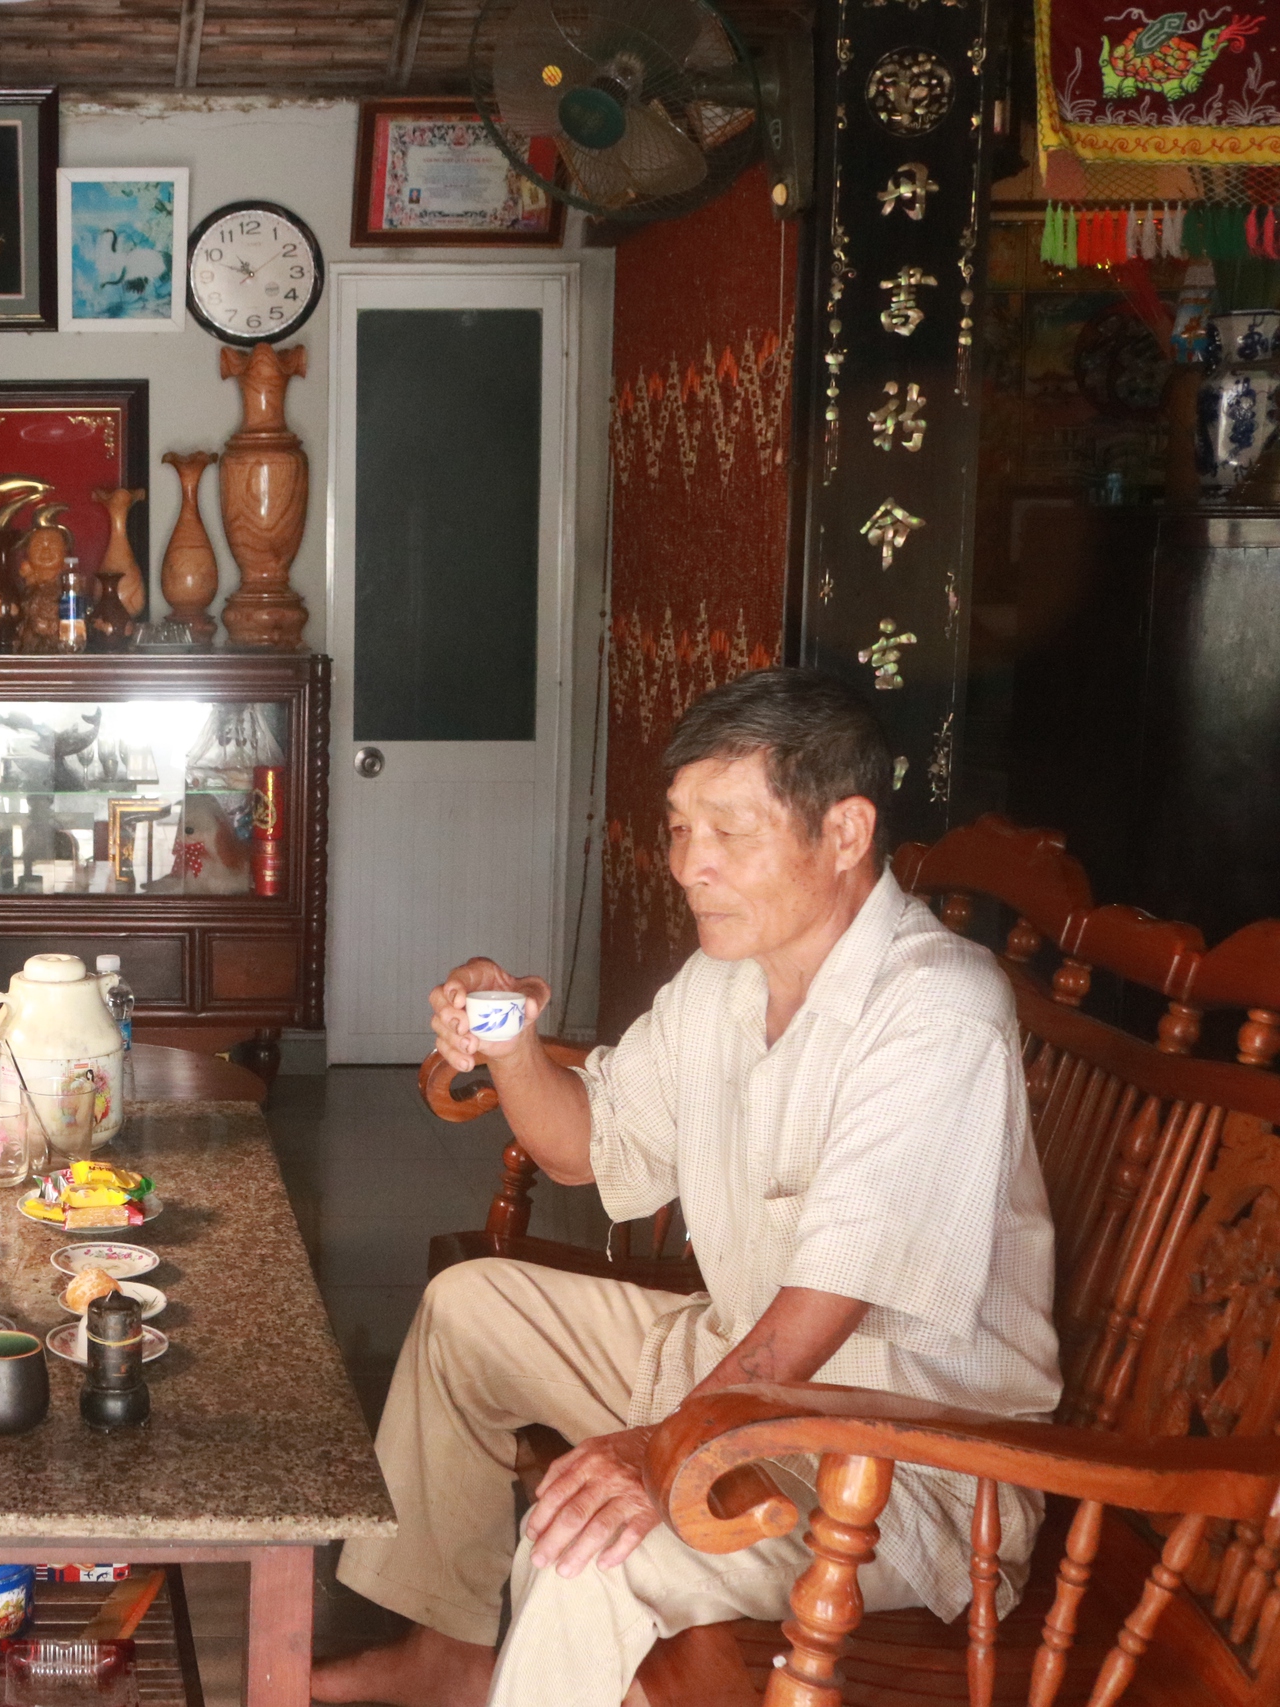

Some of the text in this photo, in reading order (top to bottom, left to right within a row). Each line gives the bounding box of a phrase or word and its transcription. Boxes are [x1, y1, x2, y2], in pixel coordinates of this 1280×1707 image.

[239, 220, 261, 236] 12
[272, 226, 278, 241] 1
[220, 229, 233, 243] 11
[204, 248, 223, 263] 10
[282, 243, 298, 258] 2
[200, 270, 215, 285] 9
[289, 265, 305, 280] 3
[207, 291, 223, 306] 8
[284, 287, 299, 302] 4
[225, 308, 238, 323] 7
[269, 306, 284, 321] 5
[246, 314, 262, 329] 6
